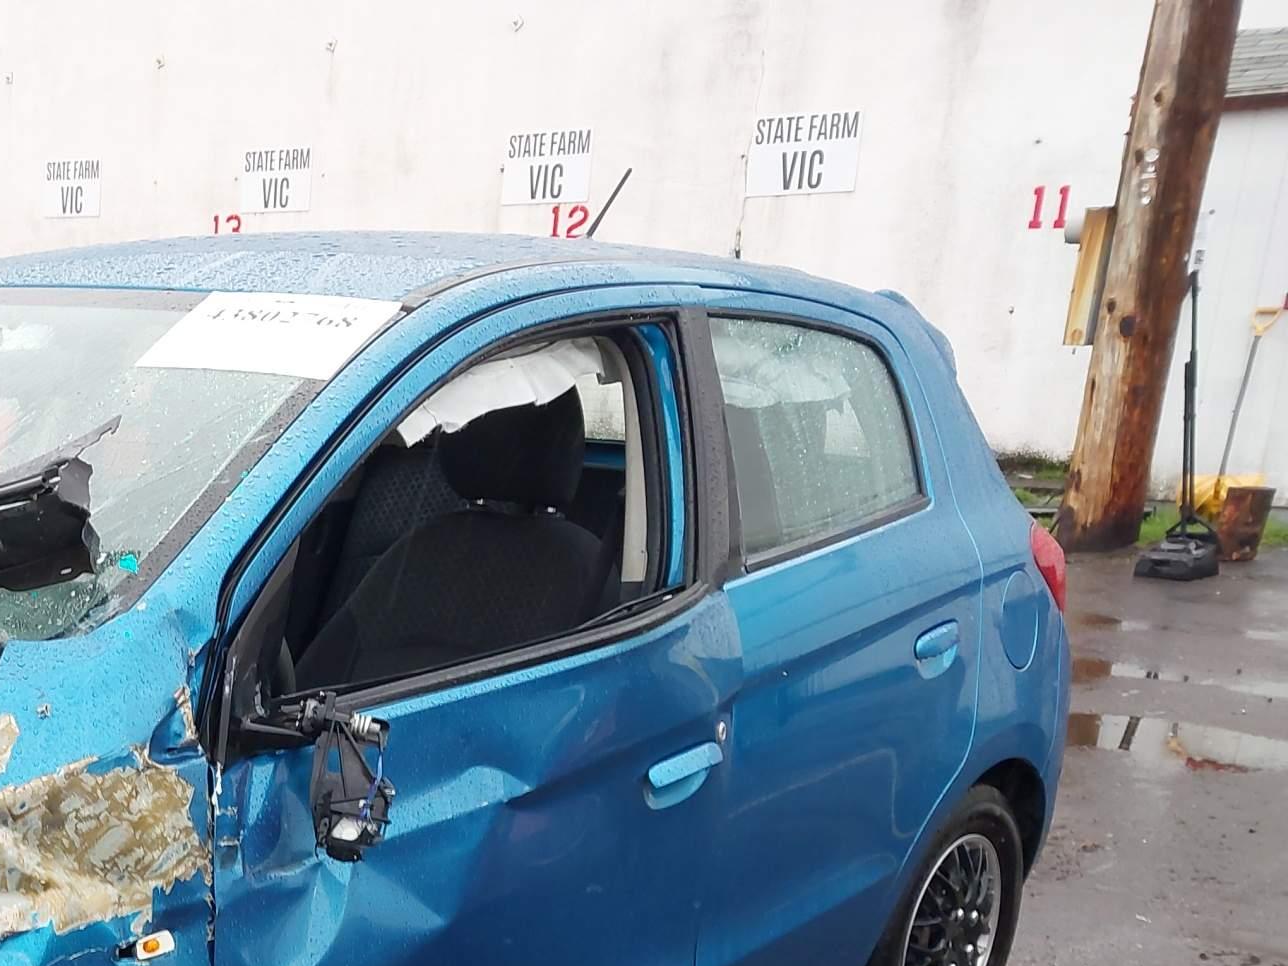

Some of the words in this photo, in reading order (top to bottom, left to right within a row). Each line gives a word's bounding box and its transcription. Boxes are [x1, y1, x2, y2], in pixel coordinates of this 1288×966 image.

[508, 134, 547, 159] STATE
[549, 129, 592, 157] FARM
[755, 116, 805, 145] STATE
[808, 111, 860, 141] FARM
[46, 161, 72, 181] STATE
[73, 160, 100, 180] FARM
[244, 151, 276, 173] STATE
[278, 148, 311, 171] FARM
[781, 149, 825, 191] VIC
[262, 177, 290, 209] VIC
[528, 163, 564, 200] VIC
[61, 185, 83, 215] VIC
[1028, 185, 1071, 229] 11
[550, 205, 590, 238] 12
